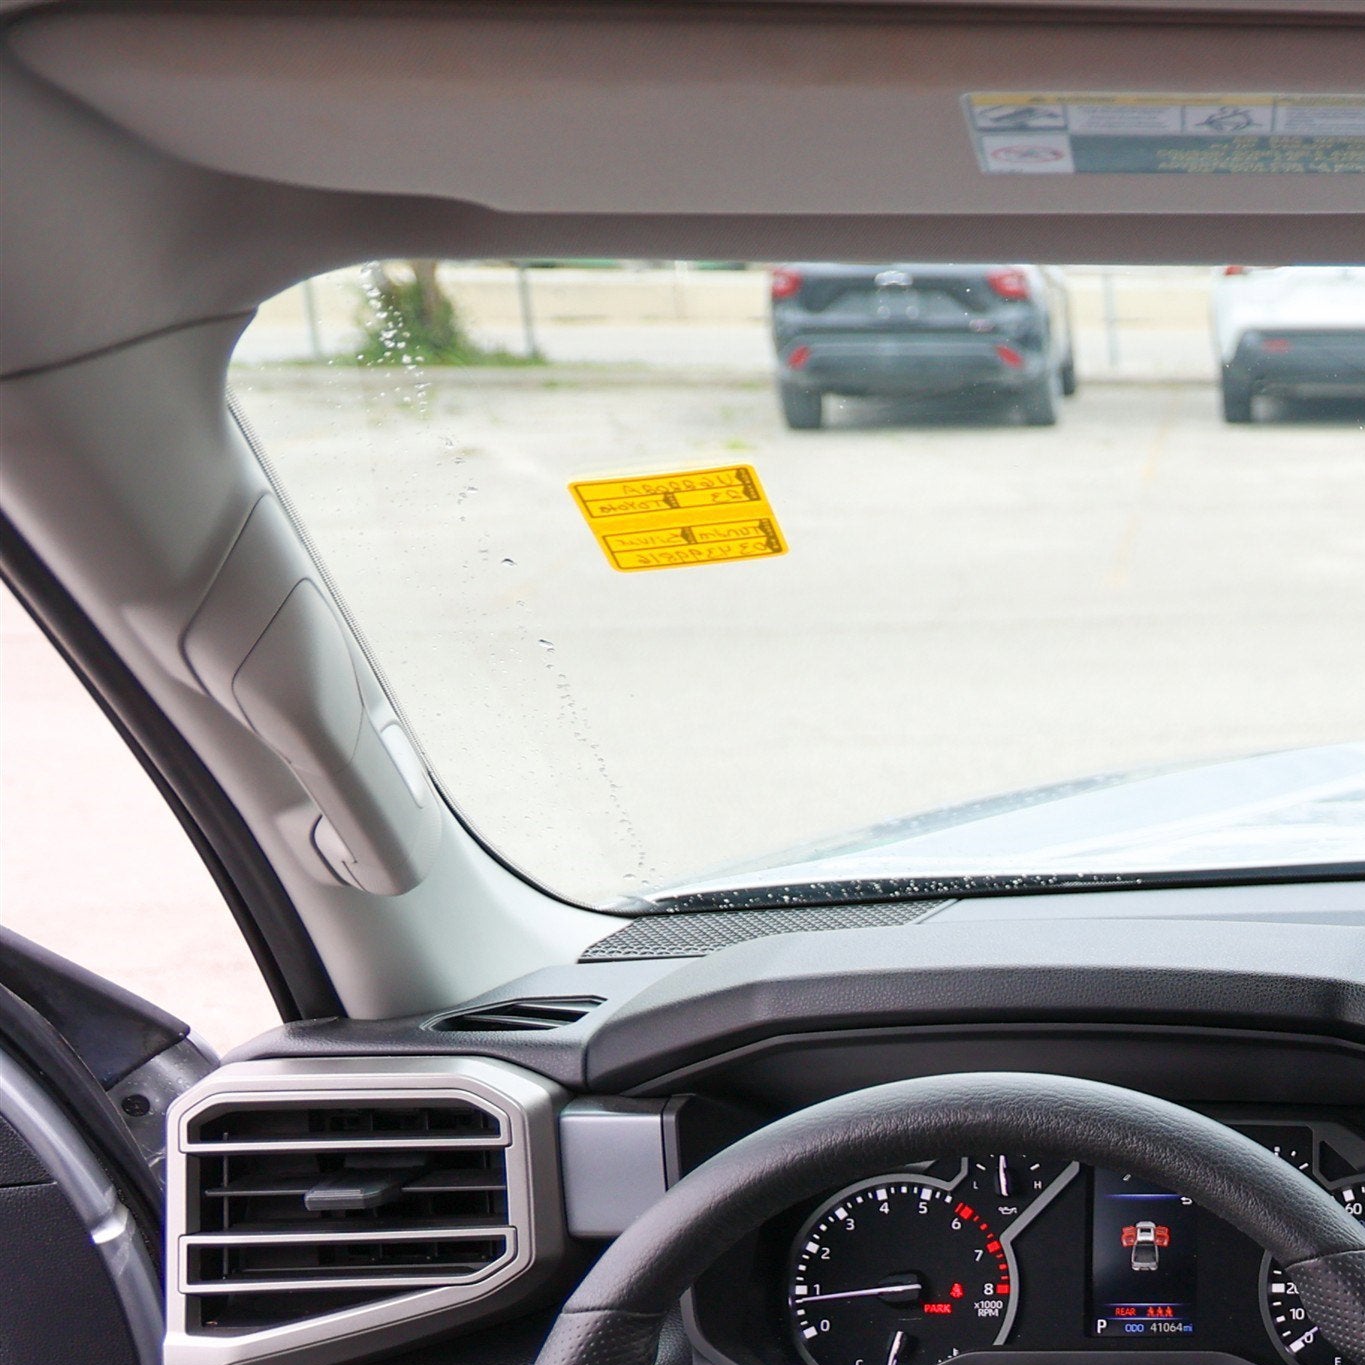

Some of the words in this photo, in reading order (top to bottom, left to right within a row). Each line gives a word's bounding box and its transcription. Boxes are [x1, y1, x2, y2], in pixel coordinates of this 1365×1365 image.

[973, 1181, 978, 1189] L
[1034, 1181, 1042, 1189] H
[879, 1202, 889, 1213] 4
[918, 1202, 928, 1213] 5
[1345, 1204, 1362, 1214] 60
[846, 1219, 855, 1230] 3
[951, 1218, 961, 1230] 6
[820, 1248, 830, 1259] 2
[974, 1250, 983, 1262] 7
[813, 1284, 820, 1295] 1
[984, 1284, 993, 1295] 8
[924, 1304, 951, 1313] PARK
[974, 1301, 1003, 1309] x1000
[978, 1309, 999, 1317] RPM
[1115, 1308, 1136, 1316] REAR
[1290, 1308, 1305, 1320] 10
[820, 1320, 830, 1331] 0
[1097, 1319, 1107, 1334] P
[1125, 1323, 1144, 1332] ODO
